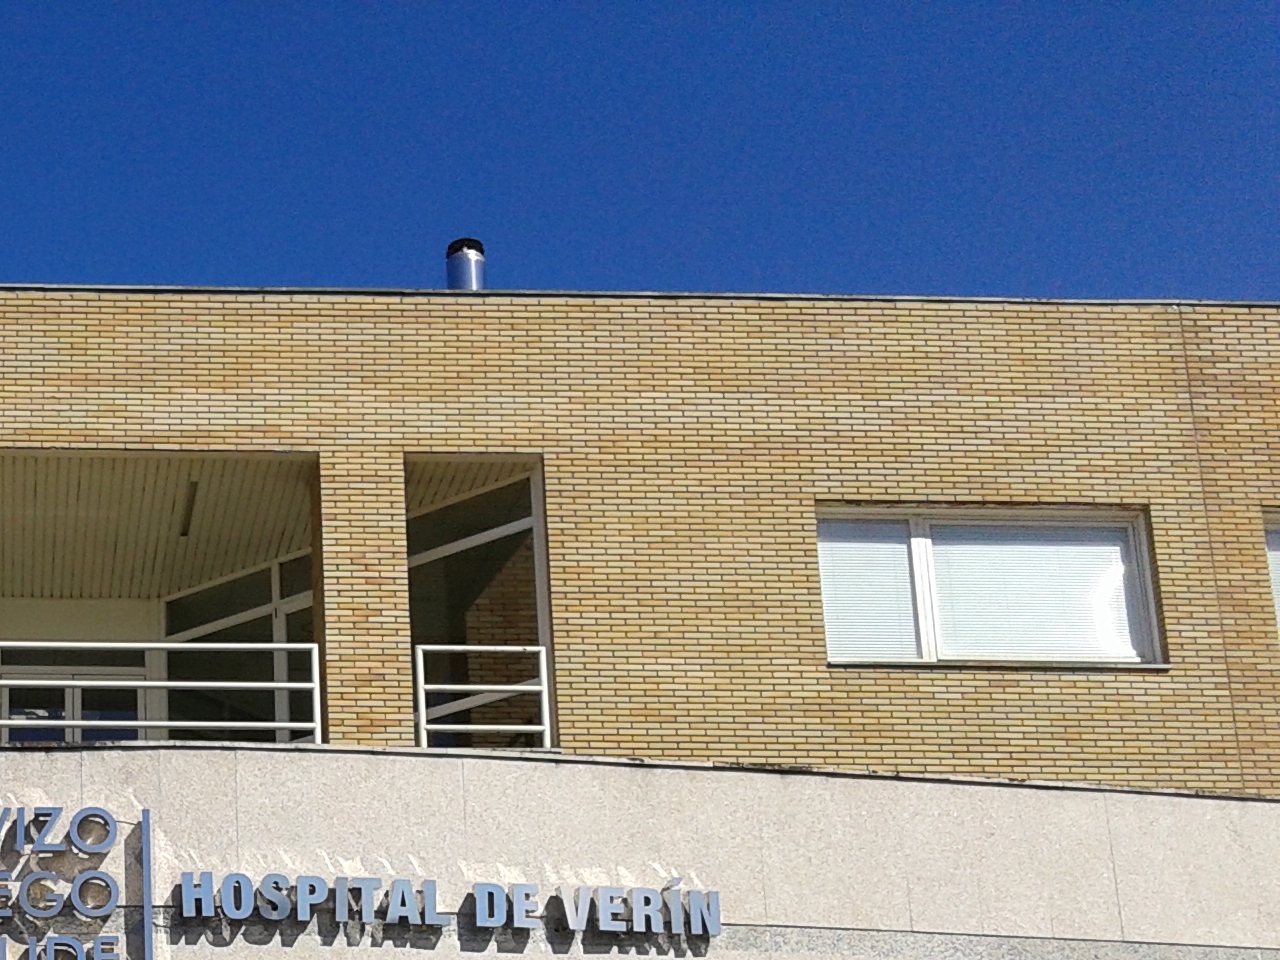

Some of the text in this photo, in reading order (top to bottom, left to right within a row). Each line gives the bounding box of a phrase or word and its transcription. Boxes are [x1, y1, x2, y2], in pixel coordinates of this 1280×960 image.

[180, 871, 721, 936] HOSPITAL DE VERÍN
